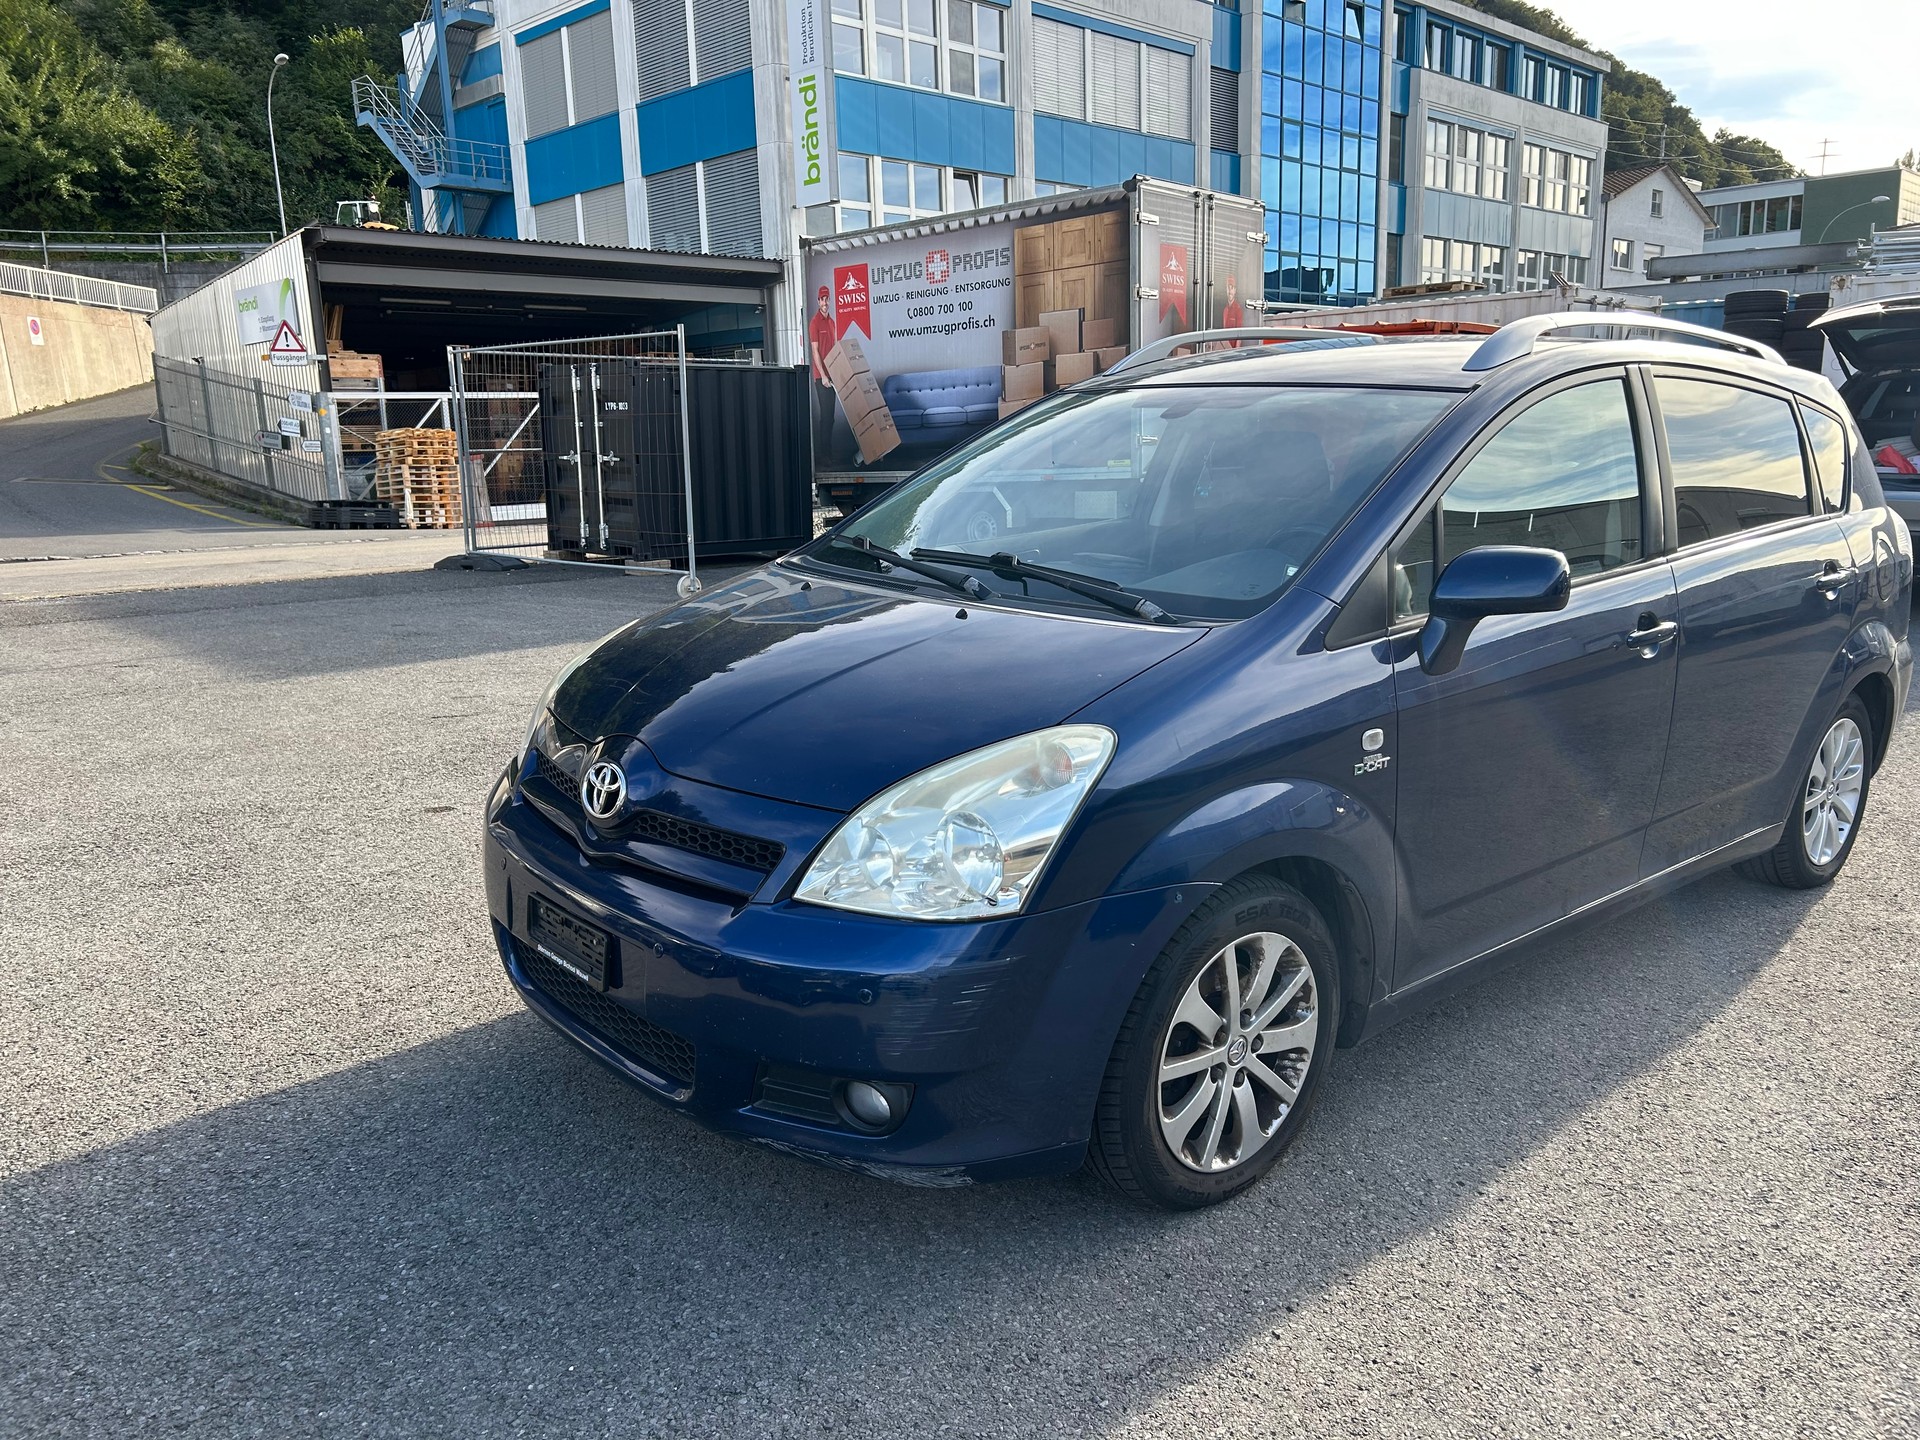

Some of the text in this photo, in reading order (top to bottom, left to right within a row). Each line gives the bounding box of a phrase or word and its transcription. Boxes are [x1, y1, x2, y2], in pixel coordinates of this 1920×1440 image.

[807, 11, 815, 63] Berufliche
[798, 74, 821, 187] brändi
[871, 247, 1010, 285] UMZUG PROFIS
[1162, 273, 1185, 286] SWISS
[838, 291, 867, 306] SWISS
[873, 277, 1011, 305] UMZUG REINIGUNG ENTSORGUNG
[238, 296, 258, 313] brändi
[912, 301, 973, 318] 0800 700 100
[888, 314, 996, 338] www.umzugprofis.ch
[273, 354, 306, 363] Fussgänger
